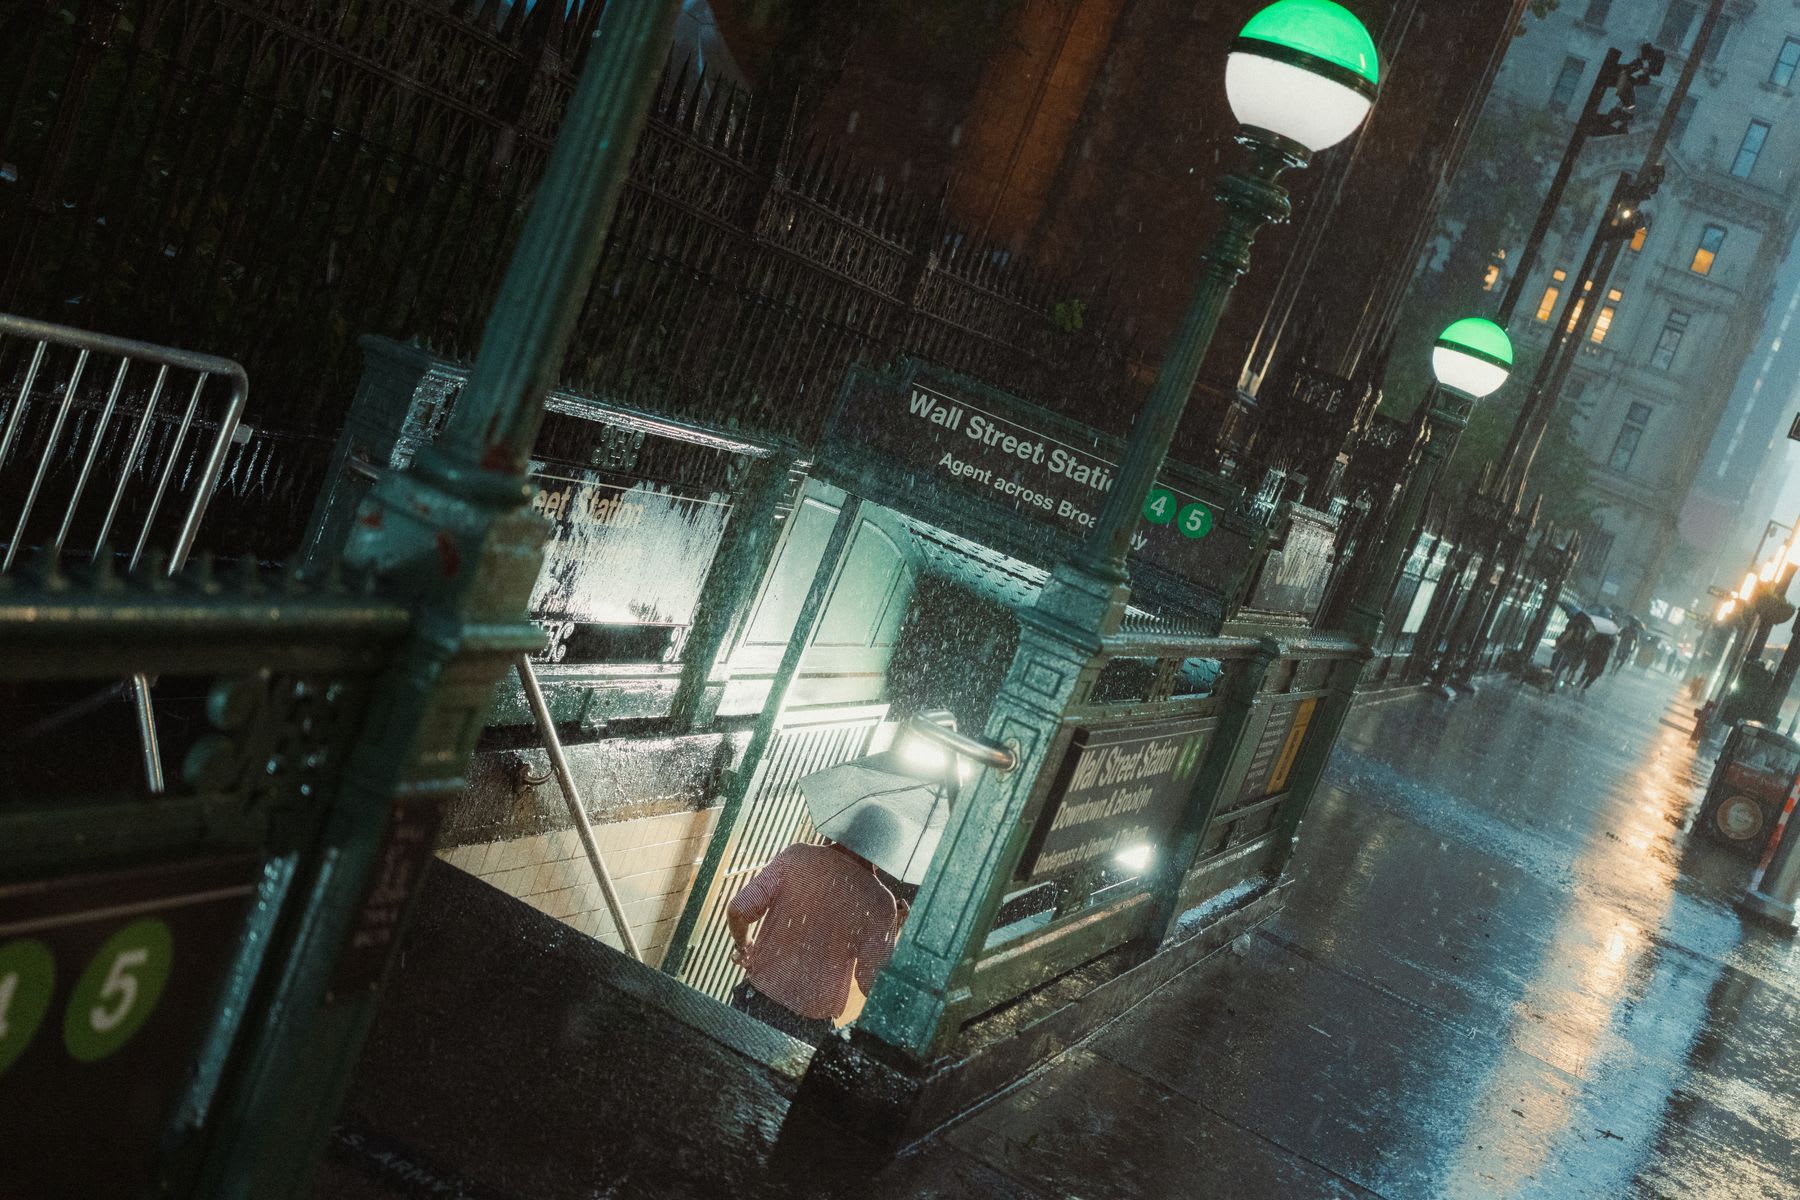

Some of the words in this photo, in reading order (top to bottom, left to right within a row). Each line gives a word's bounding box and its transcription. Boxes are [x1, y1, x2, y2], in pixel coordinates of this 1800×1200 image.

[909, 390, 964, 431] Wall
[966, 415, 1044, 465] Street
[1048, 449, 1114, 493] Stati
[532, 485, 571, 520] eet
[570, 487, 644, 528] Station
[939, 452, 993, 485] Agent
[994, 477, 1054, 511] across
[1150, 496, 1167, 517] 4
[1185, 509, 1205, 532] 5
[1069, 749, 1108, 792] Wall
[1098, 745, 1145, 787] Street
[1137, 738, 1178, 780] Station
[1050, 797, 1108, 832] Downtown
[1104, 789, 1117, 818] &
[1111, 783, 1153, 816] Brooklyn
[90, 949, 148, 1033] 5
